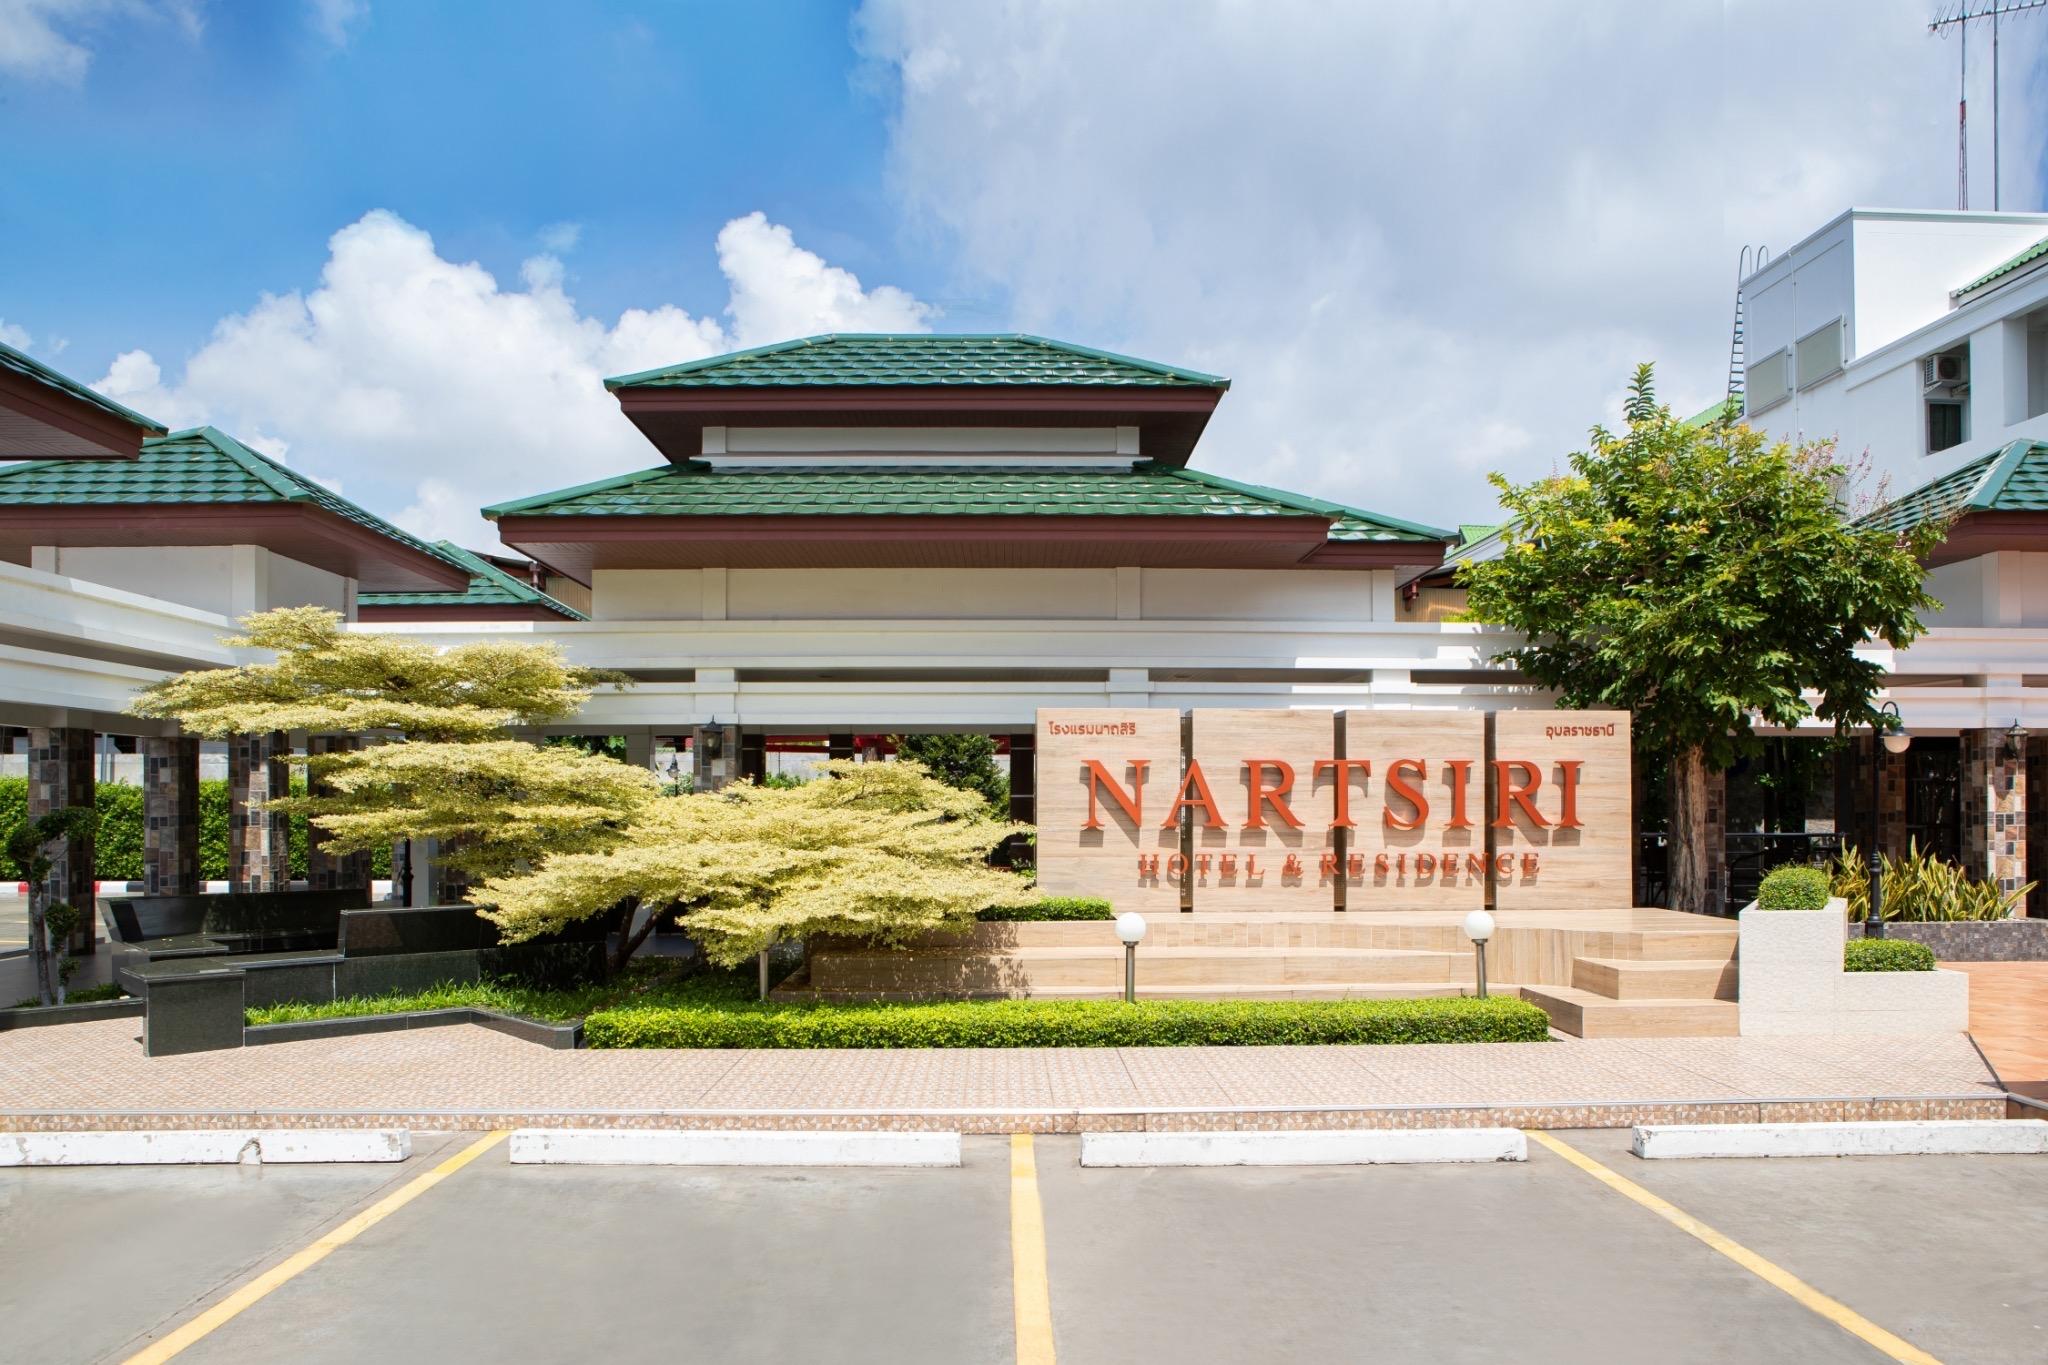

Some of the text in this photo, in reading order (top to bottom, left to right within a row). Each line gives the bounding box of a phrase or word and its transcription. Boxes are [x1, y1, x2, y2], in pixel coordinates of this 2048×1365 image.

[1545, 722, 1615, 740] อุบลราชธานี
[1080, 758, 1585, 830] NARTSIRI
[1139, 852, 1541, 877] HOTEL & RESIDENCE
